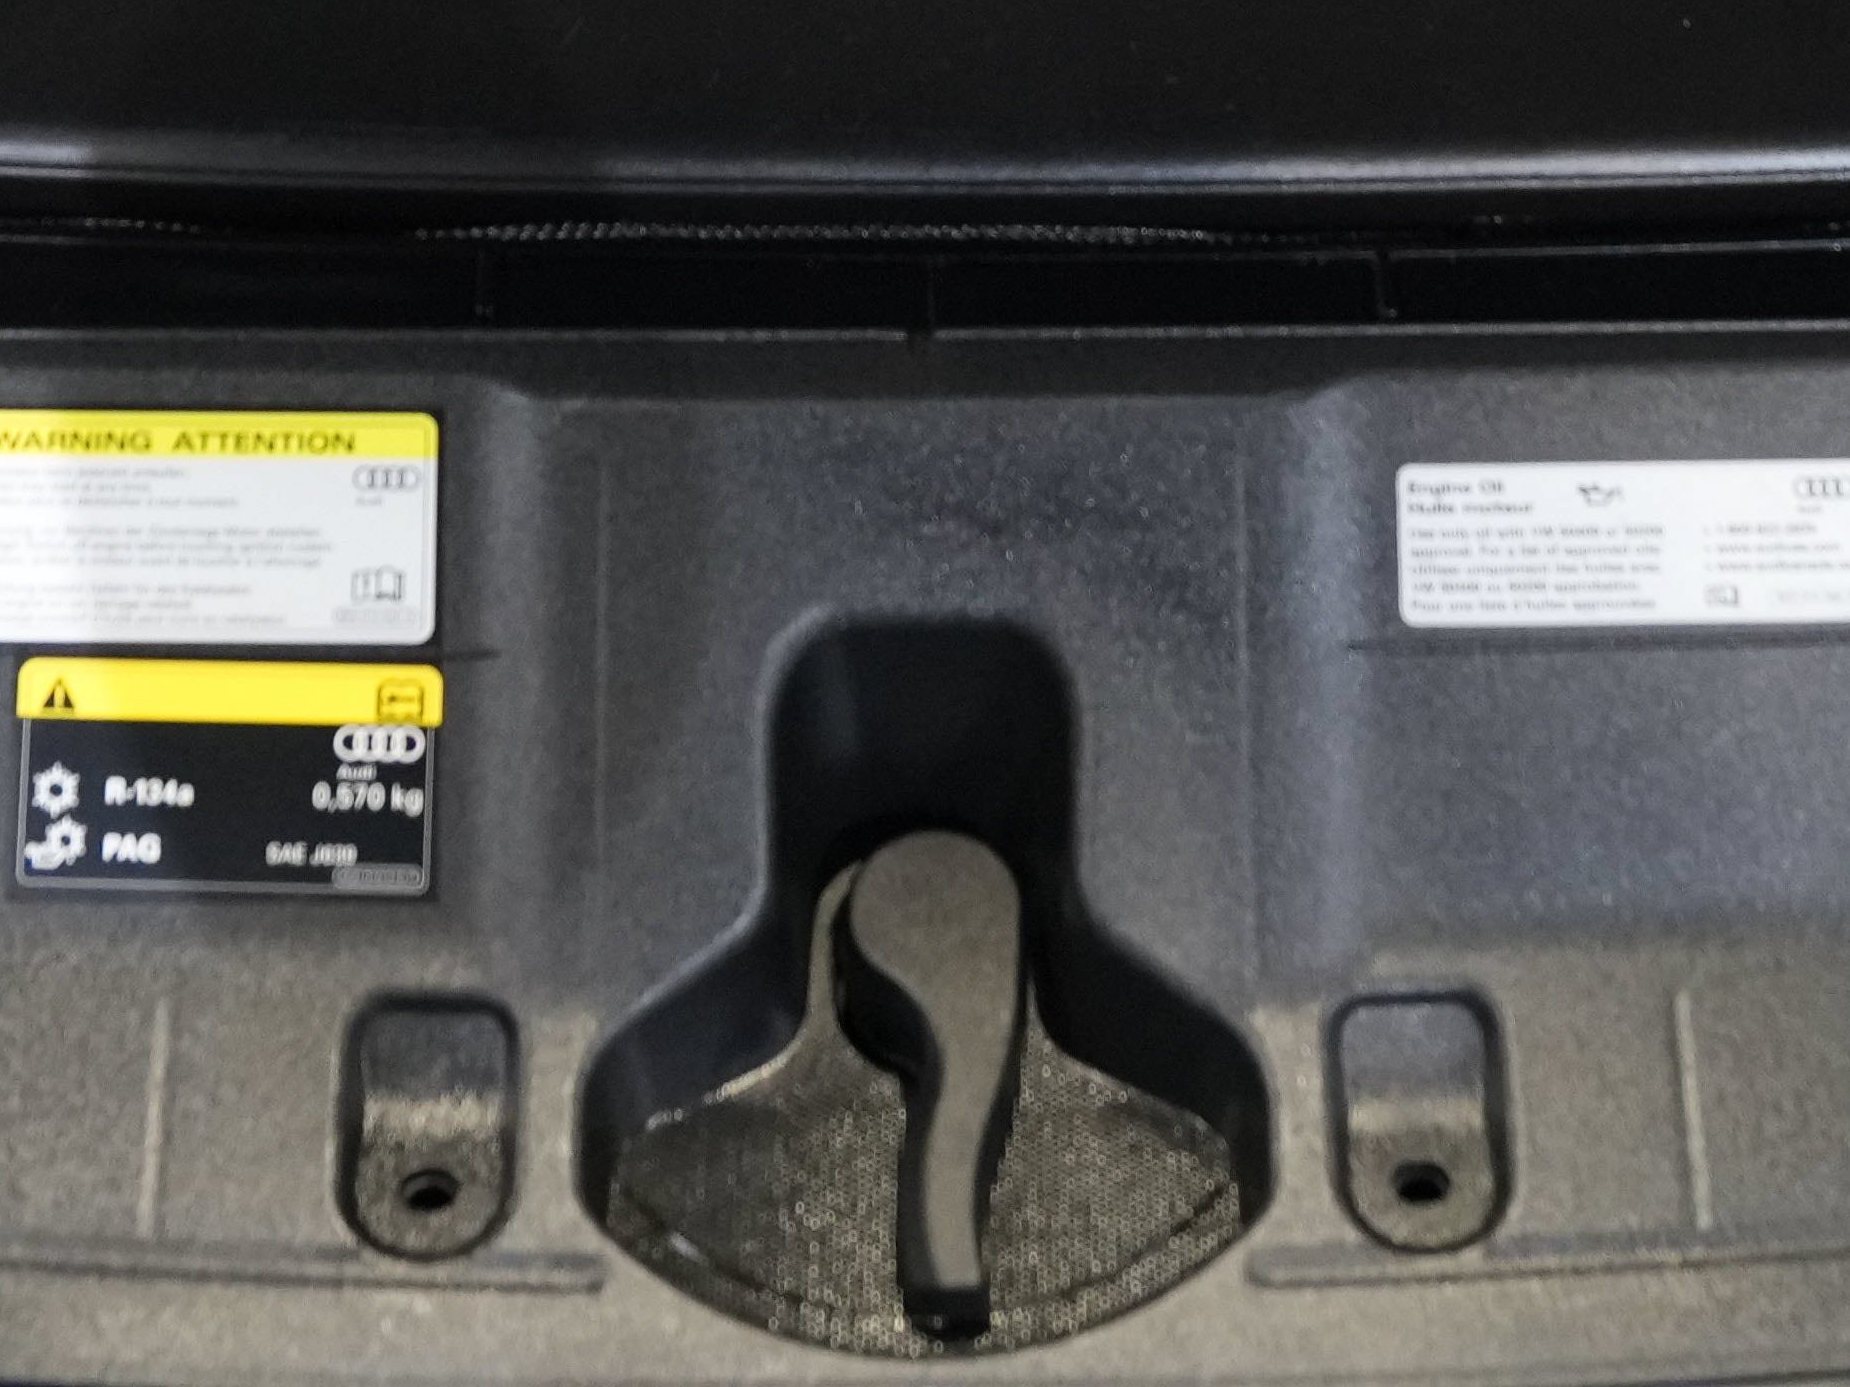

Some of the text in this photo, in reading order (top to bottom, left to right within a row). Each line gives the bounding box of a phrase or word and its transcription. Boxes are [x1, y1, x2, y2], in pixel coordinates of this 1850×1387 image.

[172, 430, 356, 454] ATTENTION
[104, 775, 195, 808] R-134a
[390, 782, 424, 817] kg
[101, 832, 162, 865] PAG
